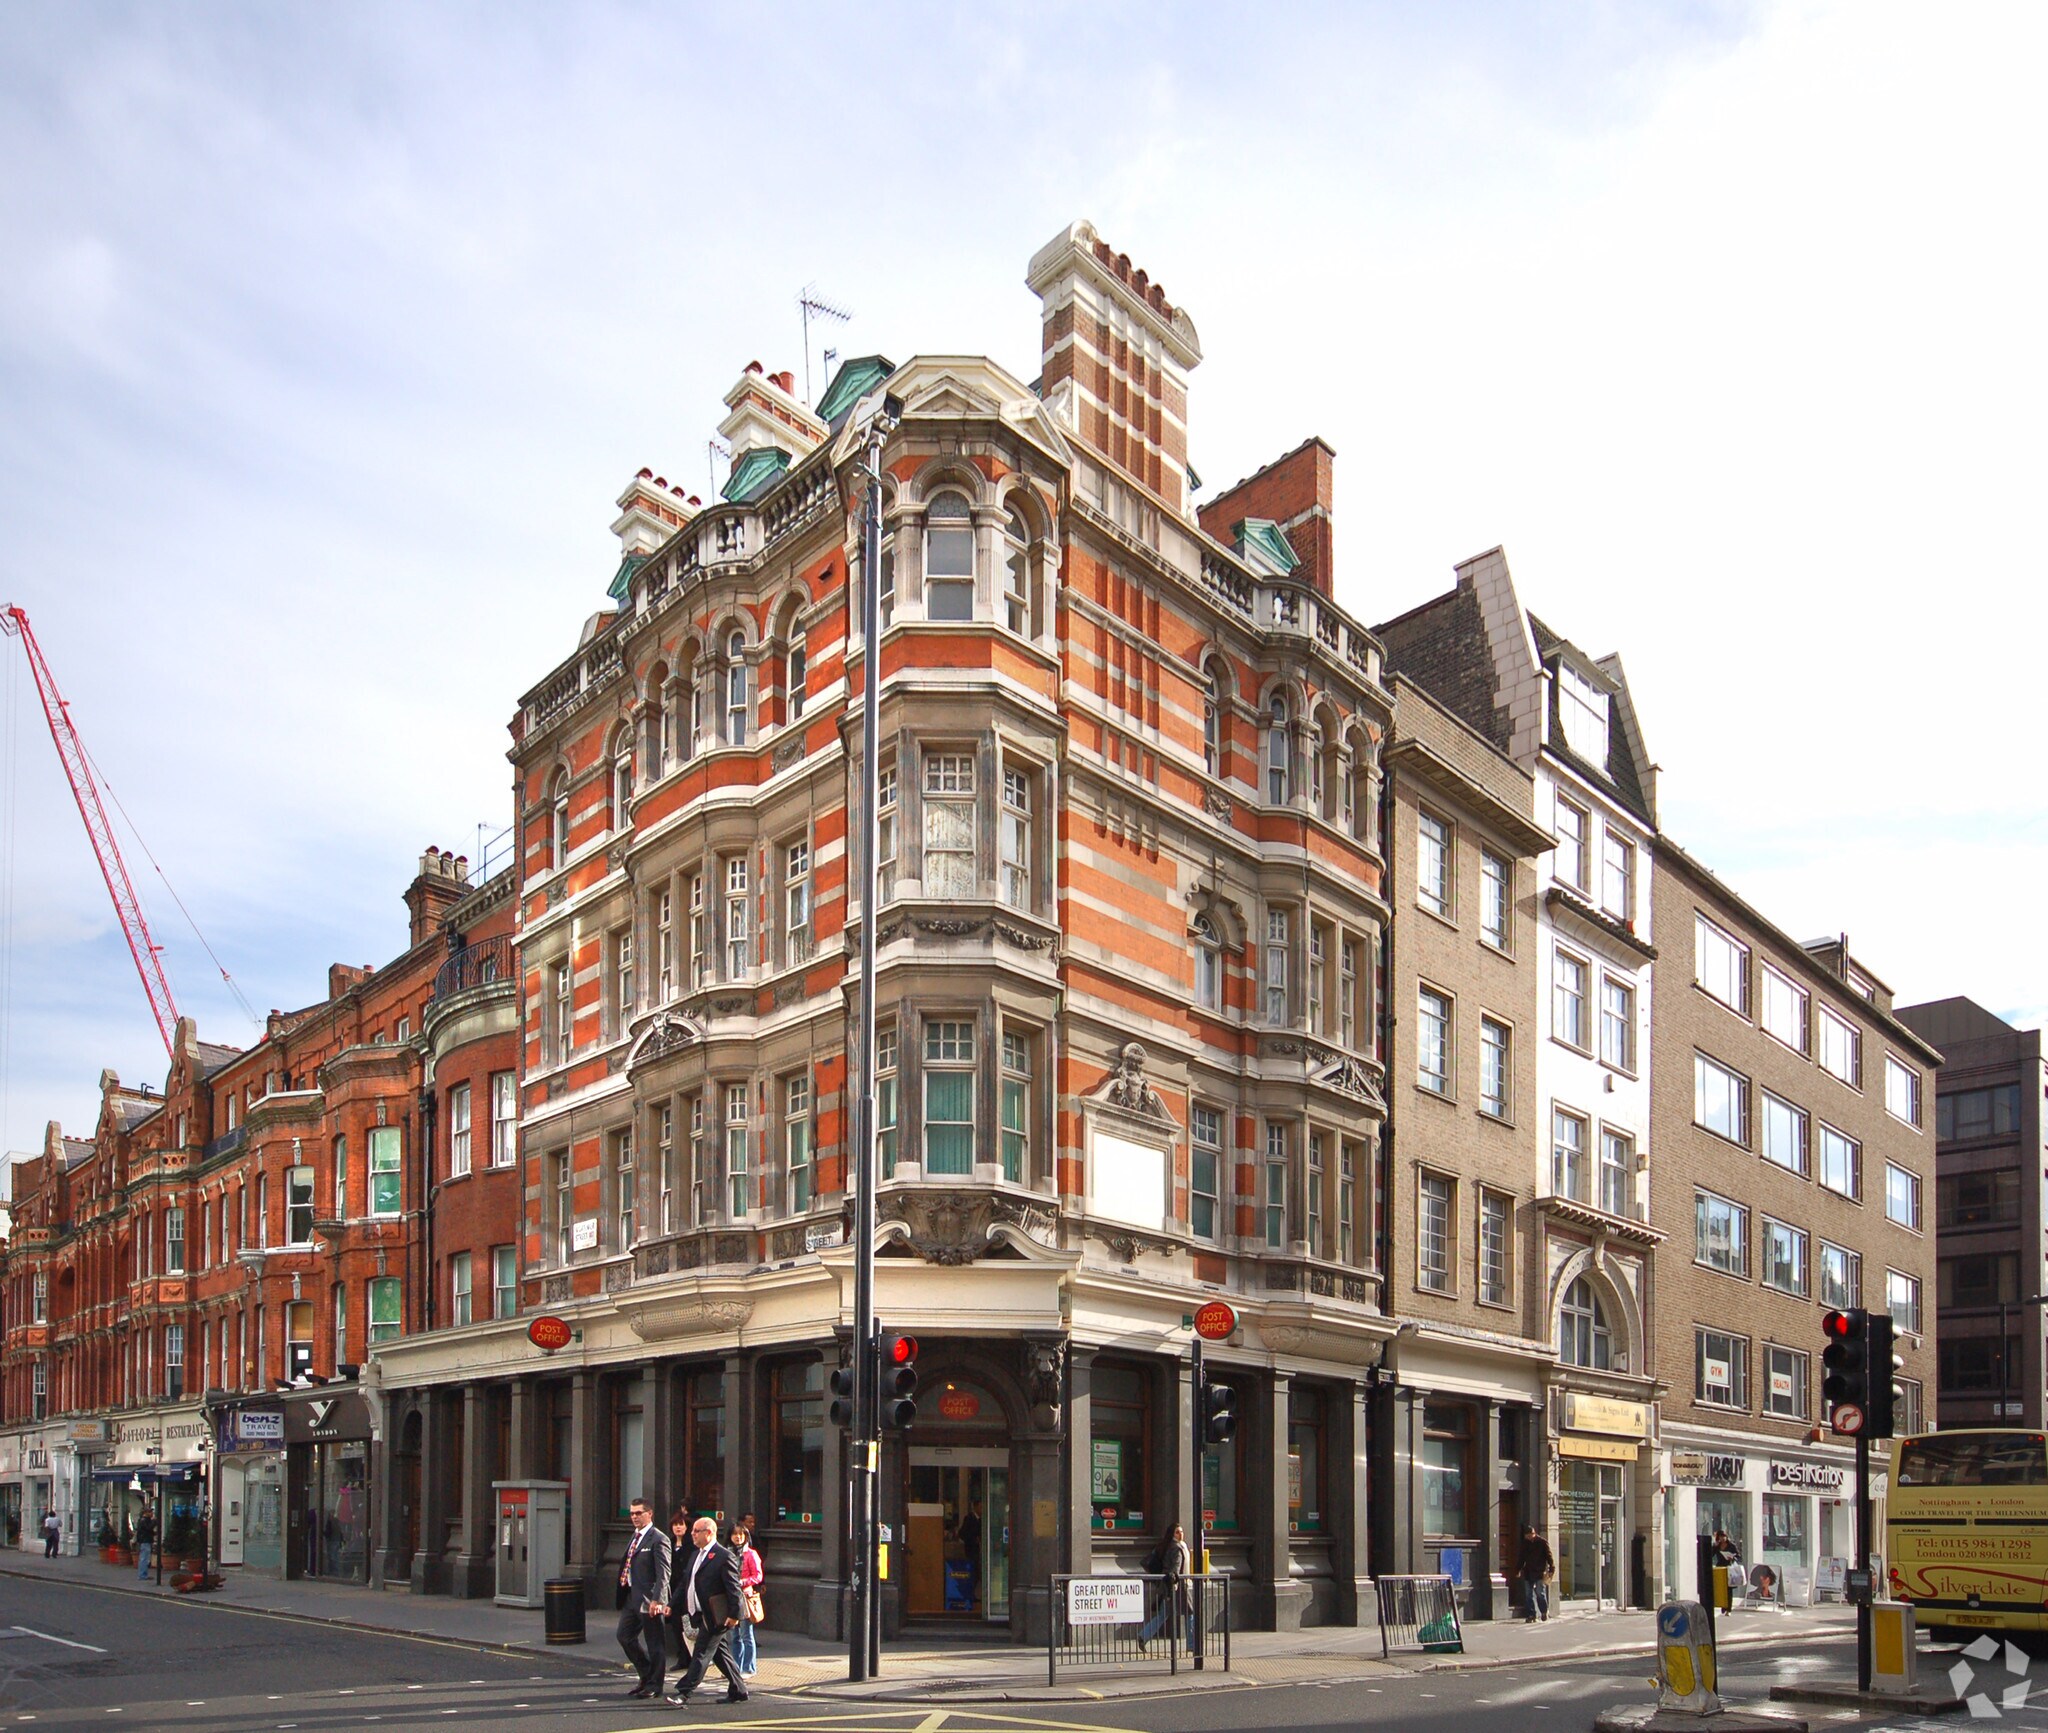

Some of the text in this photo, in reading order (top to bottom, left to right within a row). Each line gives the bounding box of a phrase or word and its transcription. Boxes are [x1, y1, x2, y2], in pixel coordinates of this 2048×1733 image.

[1202, 1312, 1224, 1322] POST
[539, 1324, 561, 1334] POST
[1200, 1322, 1228, 1332] OFFICE
[536, 1333, 566, 1343] OFFICE
[1710, 1365, 1723, 1377] GYM
[1773, 1378, 1790, 1391] HEALTH
[943, 1406, 974, 1415] OFFICE
[166, 1423, 204, 1439] RESTAURANT
[312, 1429, 338, 1437] LONDON
[1915, 1538, 2032, 1549] Tel: 0115 984 1298
[1916, 1550, 1956, 1558] London
[1979, 1551, 2004, 1559] 8961
[2007, 1552, 2031, 1560] 1812
[1905, 1565, 2027, 1598] Silverdale
[1074, 1584, 1141, 1597] GREAT PORTLAND
[1074, 1598, 1118, 1610] STREET W1
